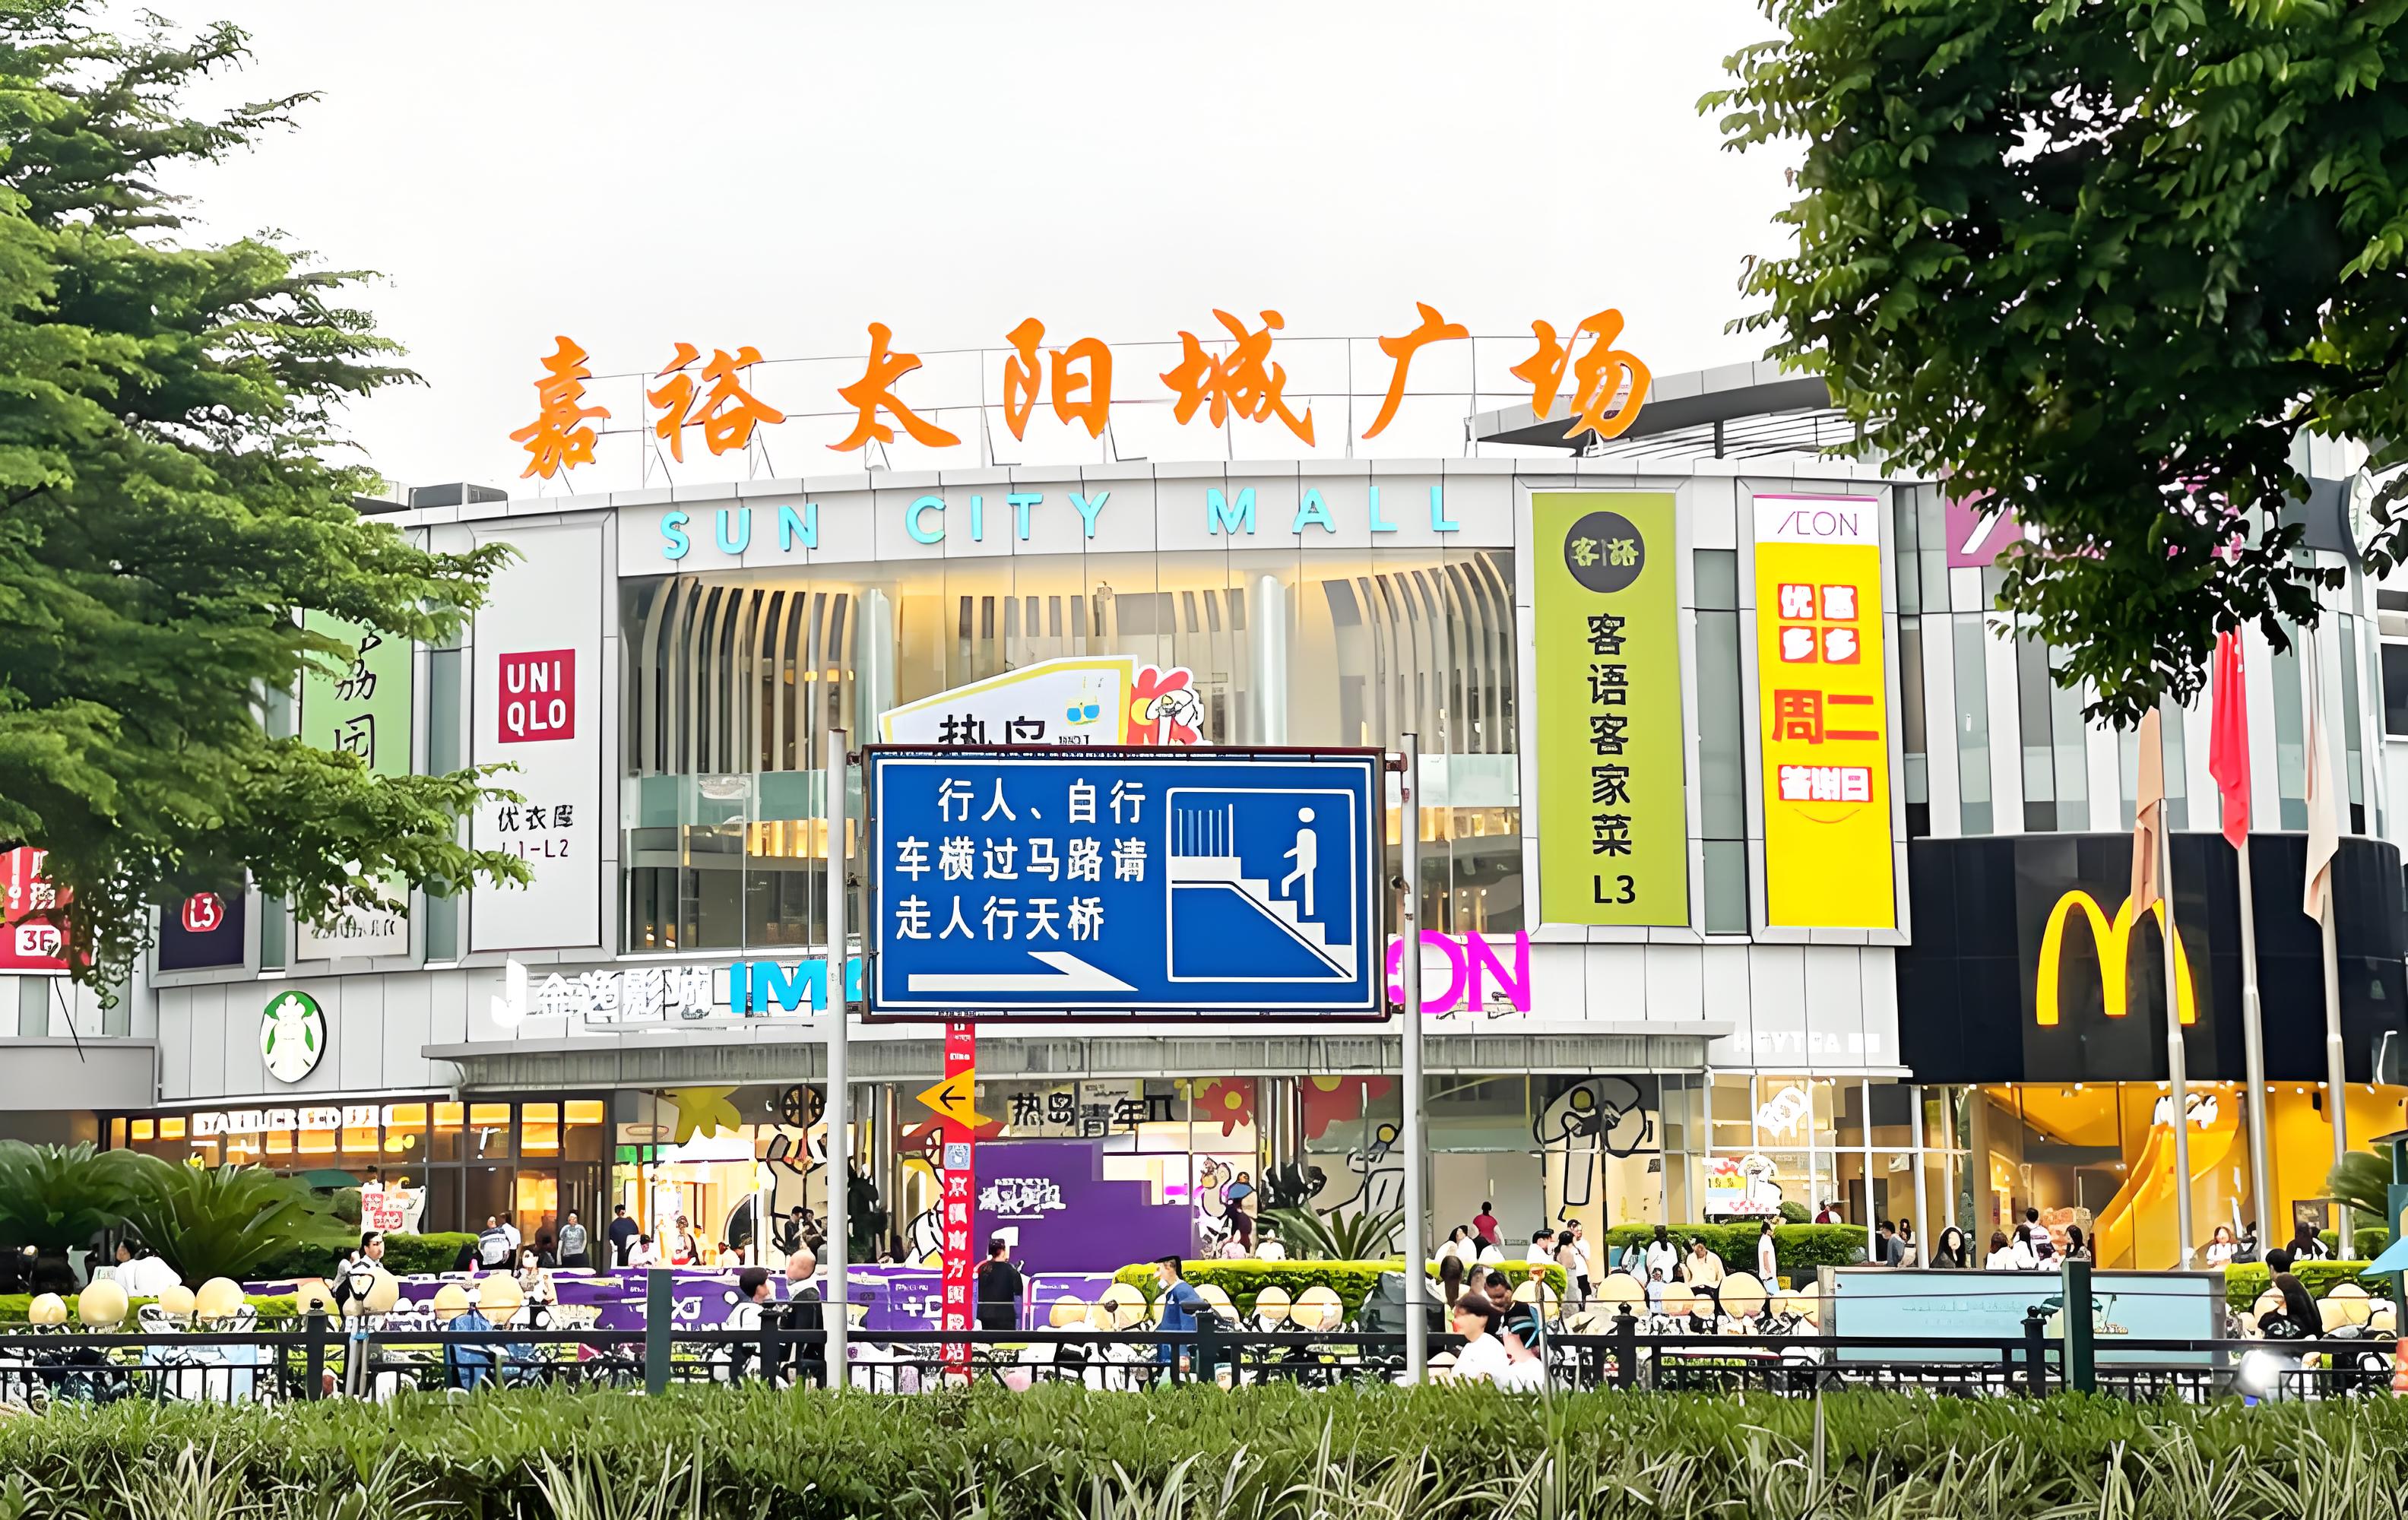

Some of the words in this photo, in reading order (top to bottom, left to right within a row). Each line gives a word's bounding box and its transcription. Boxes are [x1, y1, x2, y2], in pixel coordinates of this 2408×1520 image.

[509, 302, 1652, 480] 嘉裕太阳城广场
[661, 502, 819, 560] SUN
[905, 491, 1111, 545] CITY
[1207, 486, 1460, 535] MALL
[507, 660, 561, 693] UNI
[507, 698, 566, 736] QLO
[1587, 613, 1633, 857] 客语客家菜
[1772, 689, 1880, 744] 周二
[938, 777, 1146, 825] 行人、自行
[896, 836, 1148, 882] 车横过马路请
[1593, 874, 1636, 904] L3
[190, 898, 215, 928] L3
[896, 895, 1104, 942] 走人行天桥
